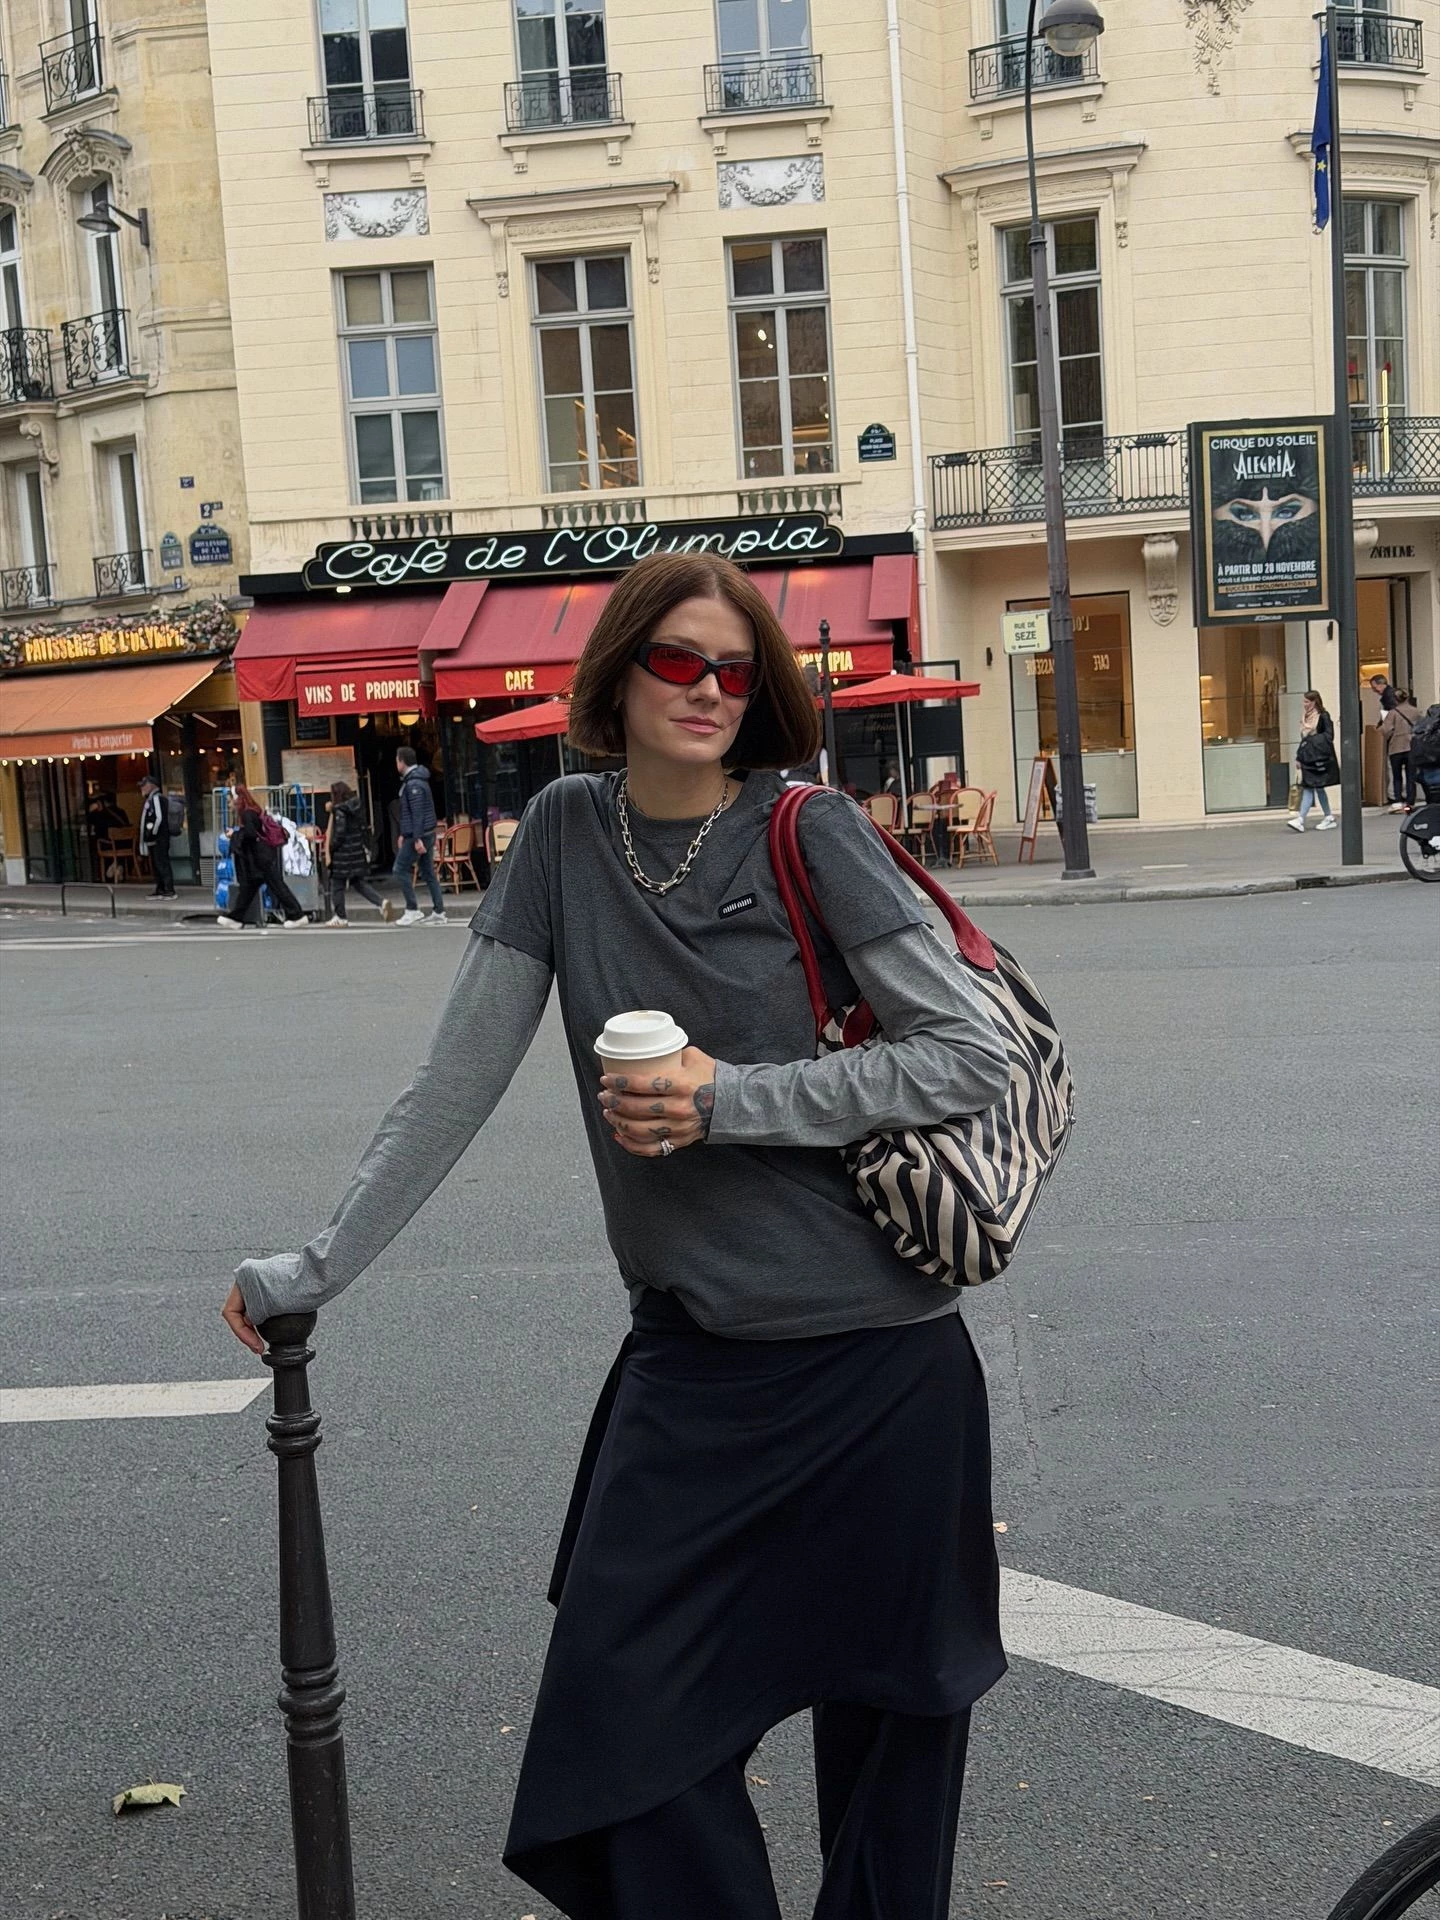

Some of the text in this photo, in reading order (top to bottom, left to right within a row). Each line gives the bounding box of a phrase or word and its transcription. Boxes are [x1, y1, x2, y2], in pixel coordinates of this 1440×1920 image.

[1211, 434, 1316, 451] CIRQUE DU SOLEIL
[326, 538, 450, 585] Café
[465, 538, 527, 570] de
[1225, 564, 1250, 575] PARTIR
[1252, 563, 1263, 574] DU
[1276, 560, 1317, 572] NOVEMBRE
[1015, 631, 1037, 641] SEZE
[505, 670, 535, 691] CAFE
[305, 685, 333, 704] VINS
[341, 683, 356, 702] DE
